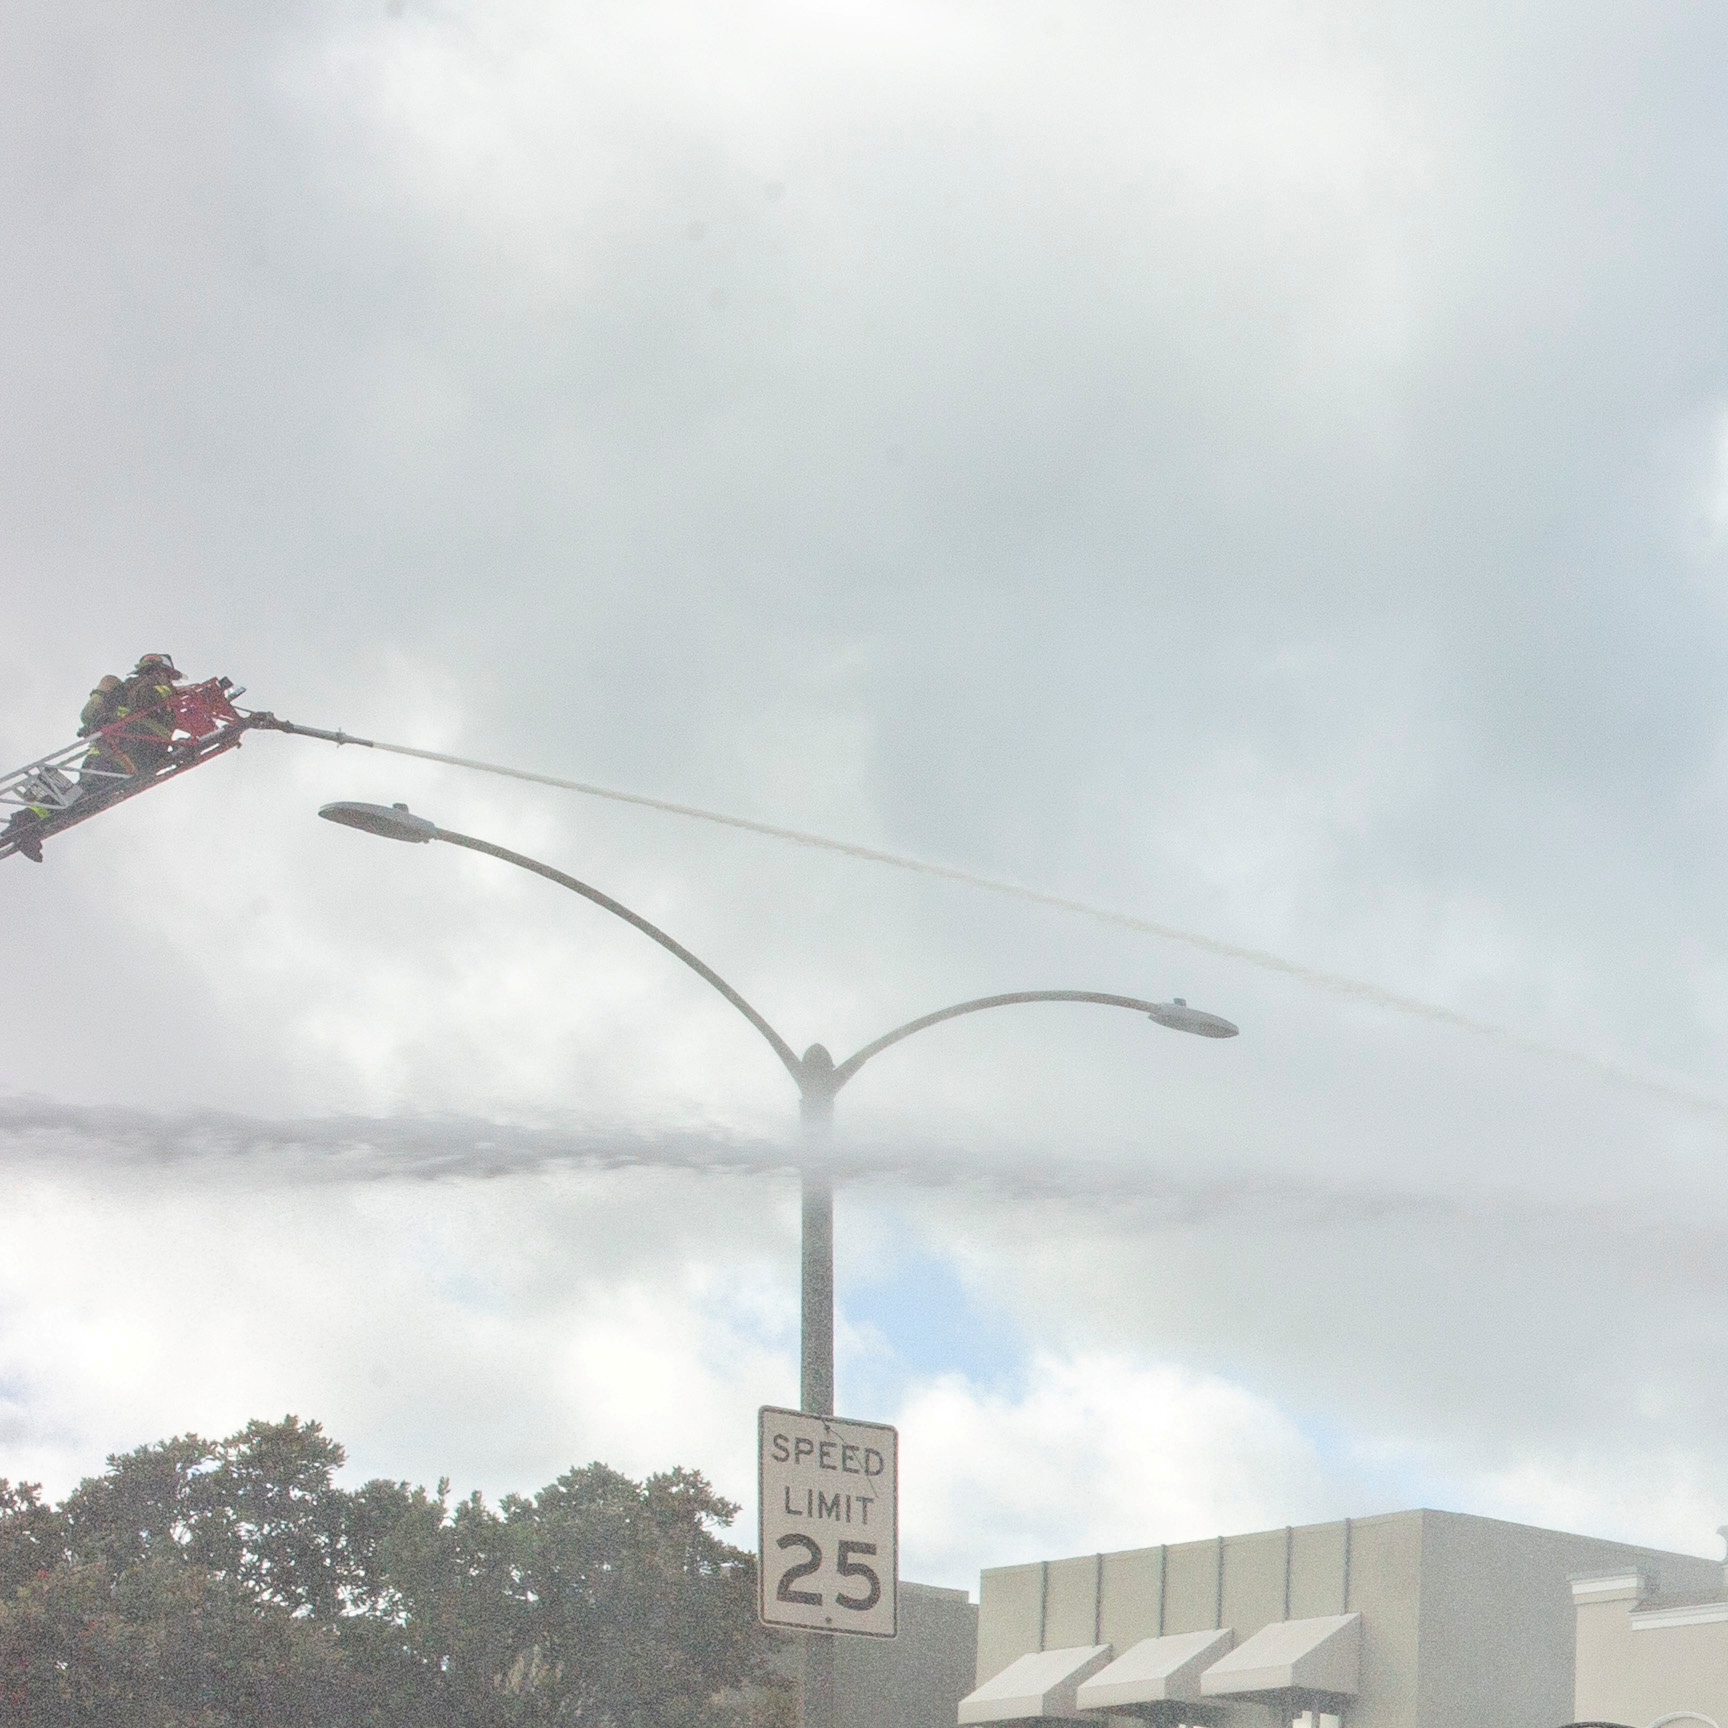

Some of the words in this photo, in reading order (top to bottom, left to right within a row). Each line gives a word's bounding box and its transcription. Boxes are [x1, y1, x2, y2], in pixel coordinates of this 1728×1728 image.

[771, 1433, 885, 1477] SPEED
[784, 1485, 875, 1525] LIMIT
[776, 1532, 882, 1612] 25
